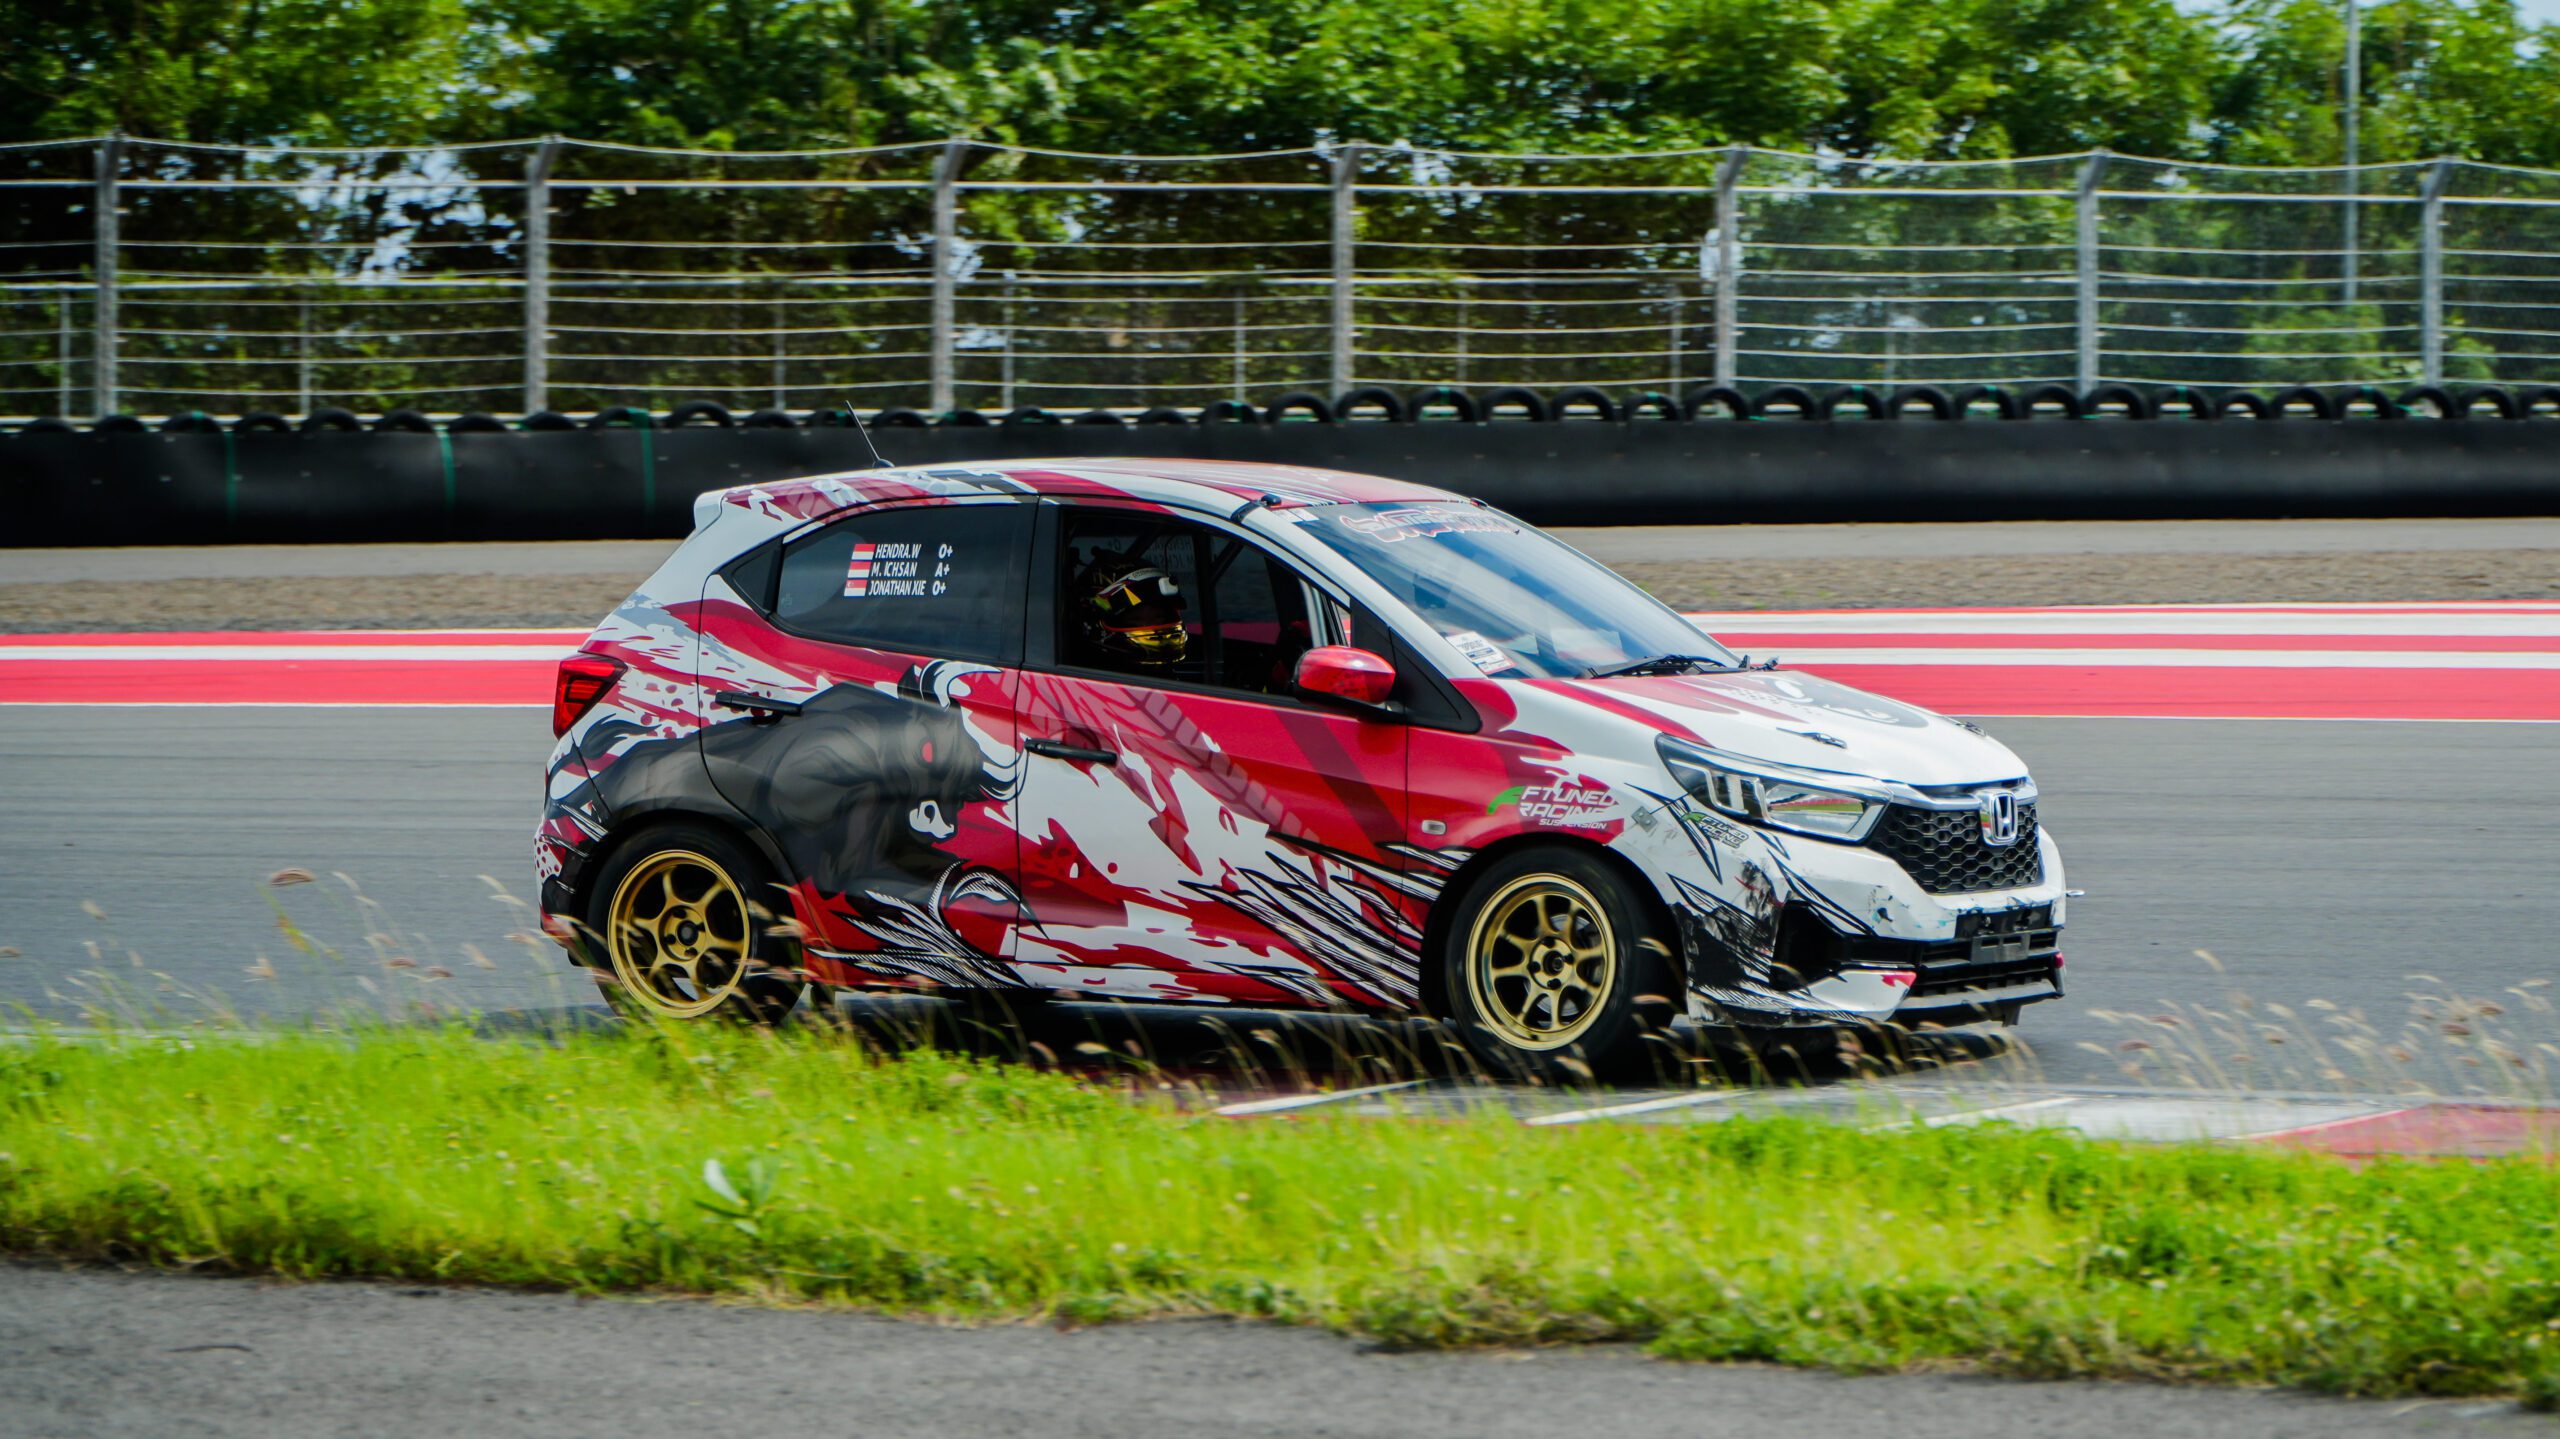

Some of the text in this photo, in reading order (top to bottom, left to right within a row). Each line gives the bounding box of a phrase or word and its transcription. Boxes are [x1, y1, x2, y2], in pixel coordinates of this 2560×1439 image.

[875, 544, 922, 559] HENDRA.W
[871, 562, 950, 577] M. ICHSAN A+
[868, 581, 911, 596] JONATHAN
[911, 581, 927, 596] XIE
[1521, 786, 1615, 806] FTUNED
[1538, 818, 1608, 829] SUSNSION
